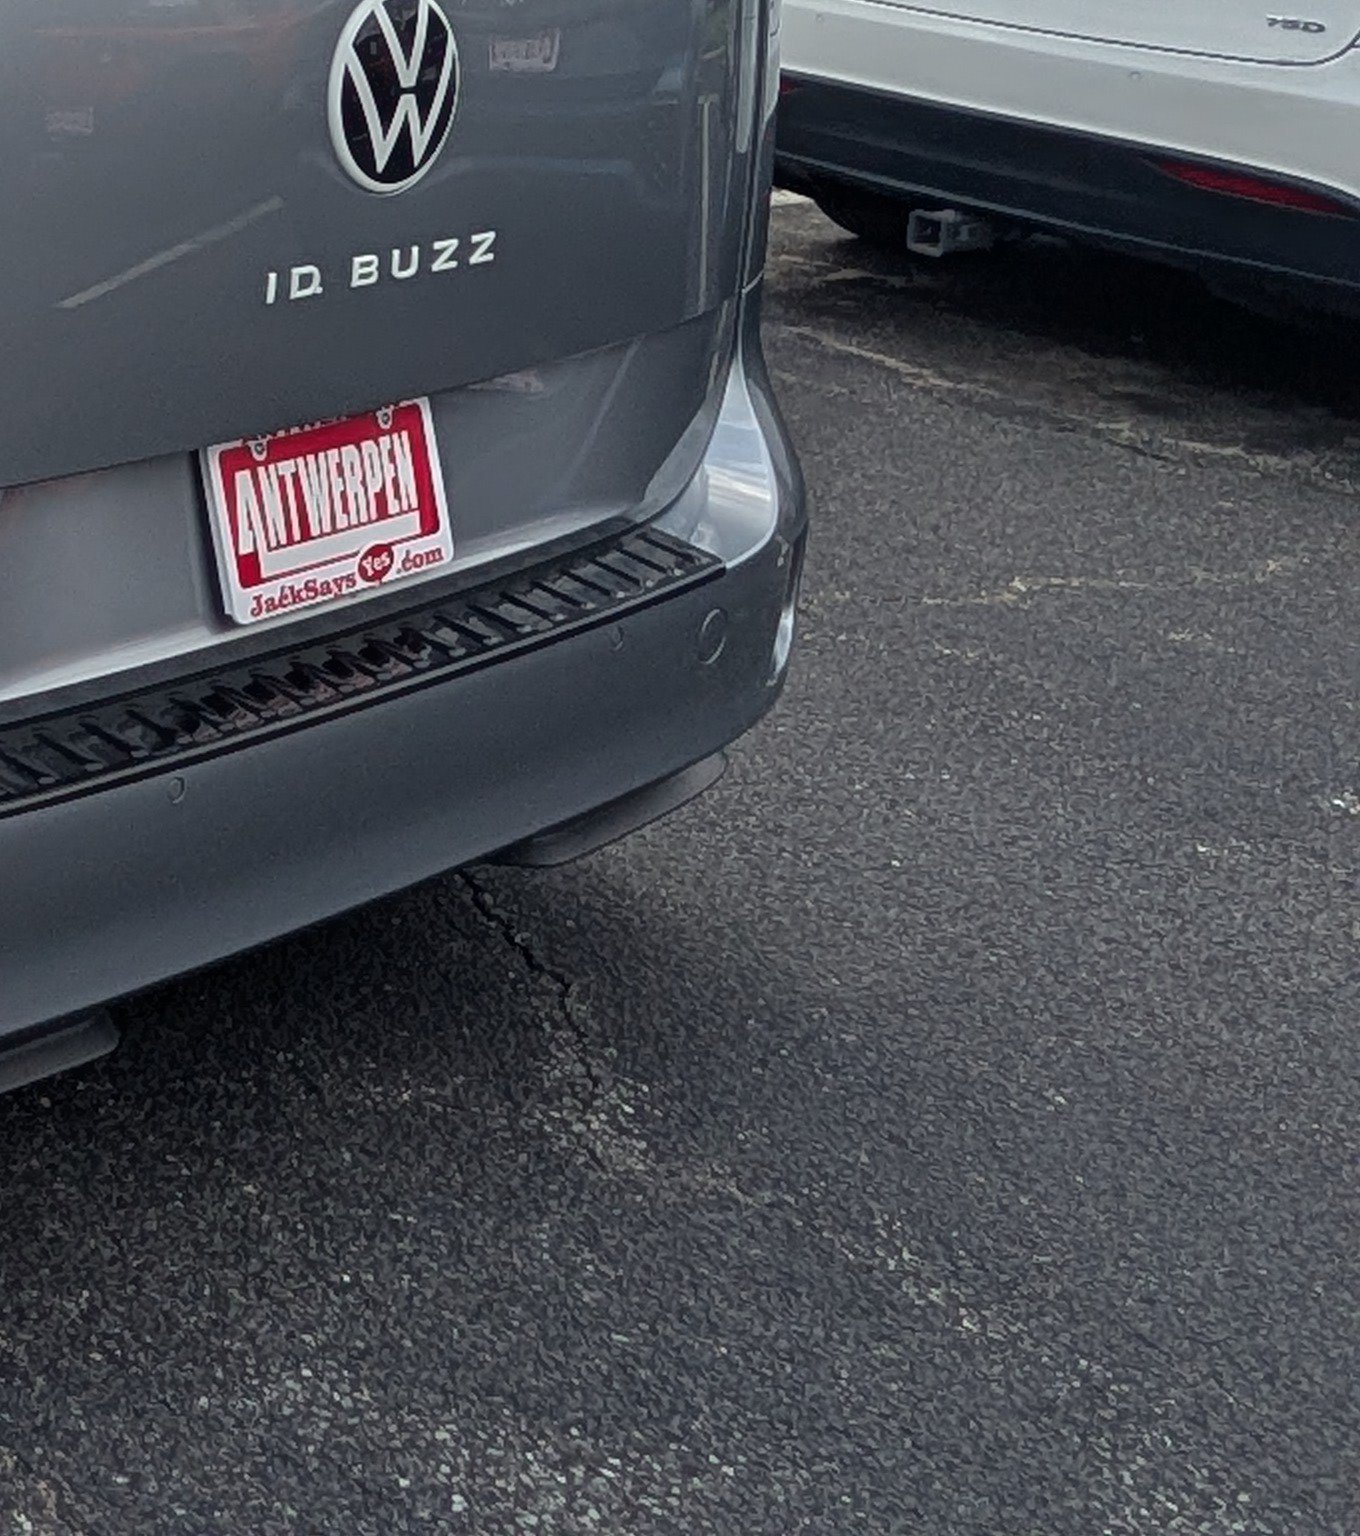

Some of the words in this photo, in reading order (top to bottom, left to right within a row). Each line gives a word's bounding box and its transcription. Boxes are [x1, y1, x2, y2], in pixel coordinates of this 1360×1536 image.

[350, 230, 497, 288] BUZZ
[235, 430, 420, 564] ANTWERPEN
[250, 573, 357, 617] JackSays
[362, 549, 392, 577] Yes
[396, 546, 444, 574] .com
